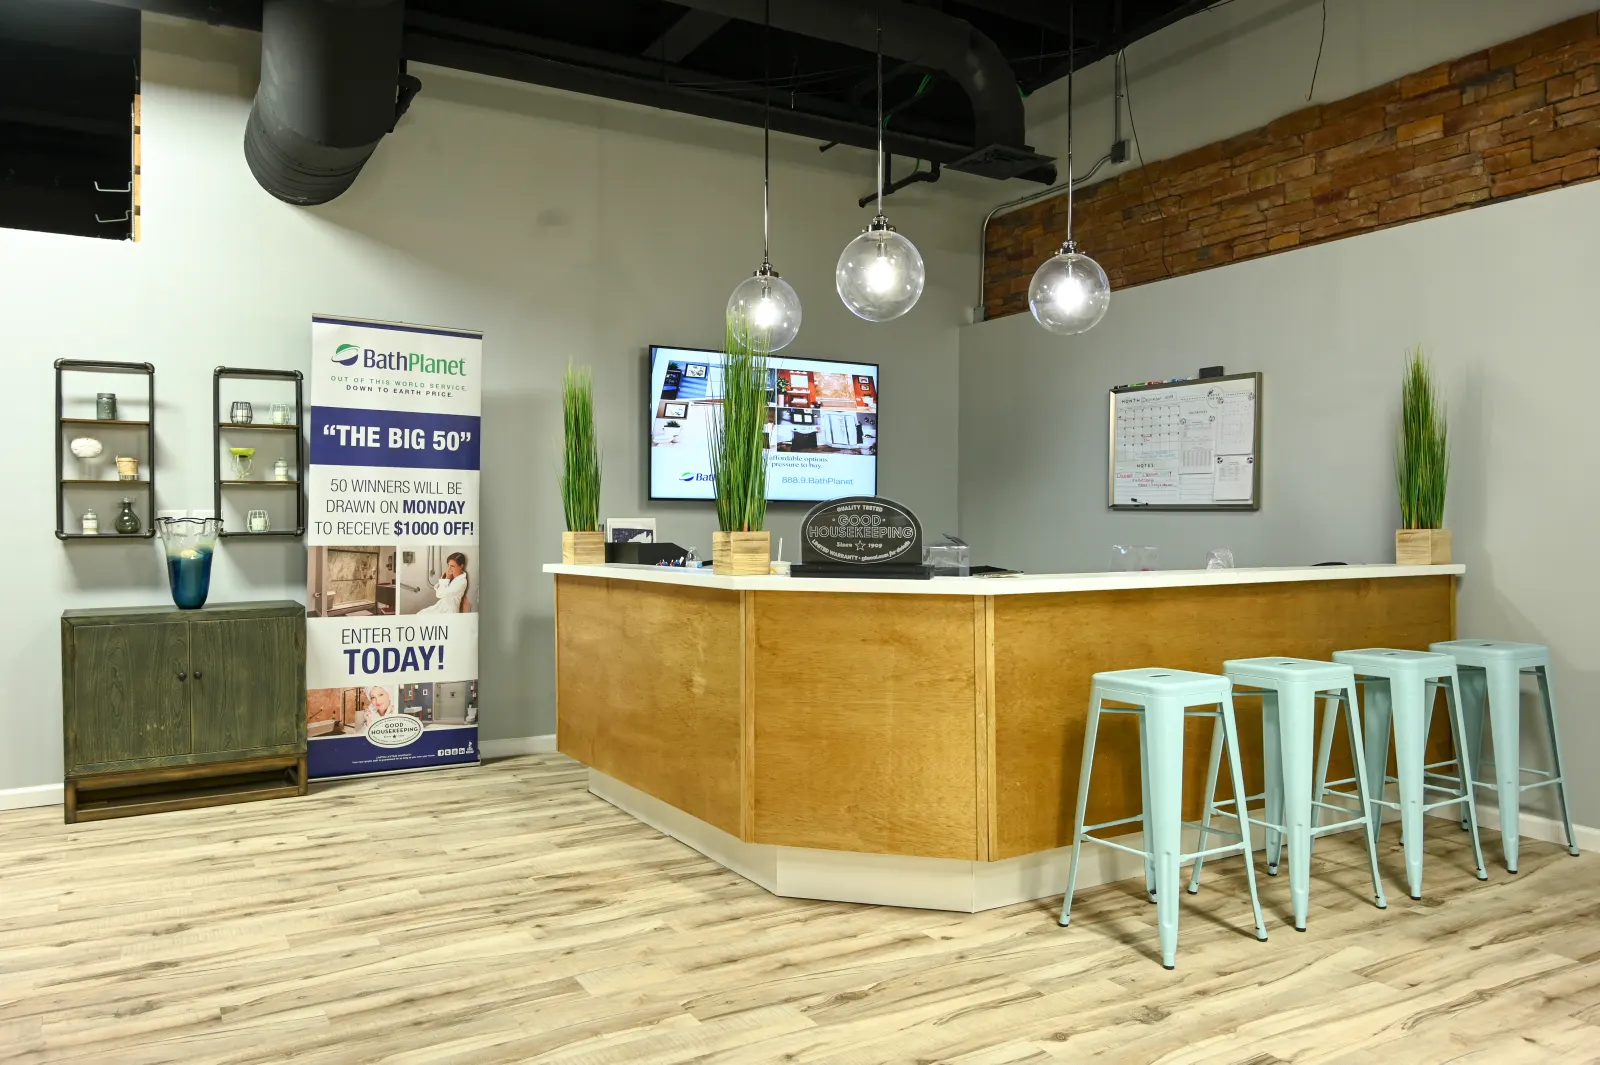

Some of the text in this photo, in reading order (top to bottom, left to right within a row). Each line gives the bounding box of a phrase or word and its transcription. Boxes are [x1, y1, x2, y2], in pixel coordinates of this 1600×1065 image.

[363, 348, 466, 376] BathPlanet
[394, 380, 425, 388] WORLD
[388, 428, 425, 450] BIG
[330, 478, 462, 495] 50 WINNERS WILL BE
[326, 499, 465, 514] DRAWN ON MONDAY
[314, 520, 474, 536] TO RECEIVE $1000 OFF!
[837, 514, 881, 527] GOOD
[809, 526, 914, 539] HOUSEKEEPING
[829, 550, 858, 560] WARRANTY
[342, 625, 448, 644] ENTER TO WIN
[343, 644, 445, 675] TODAY!
[372, 726, 418, 735] HOUSEKEEPING
